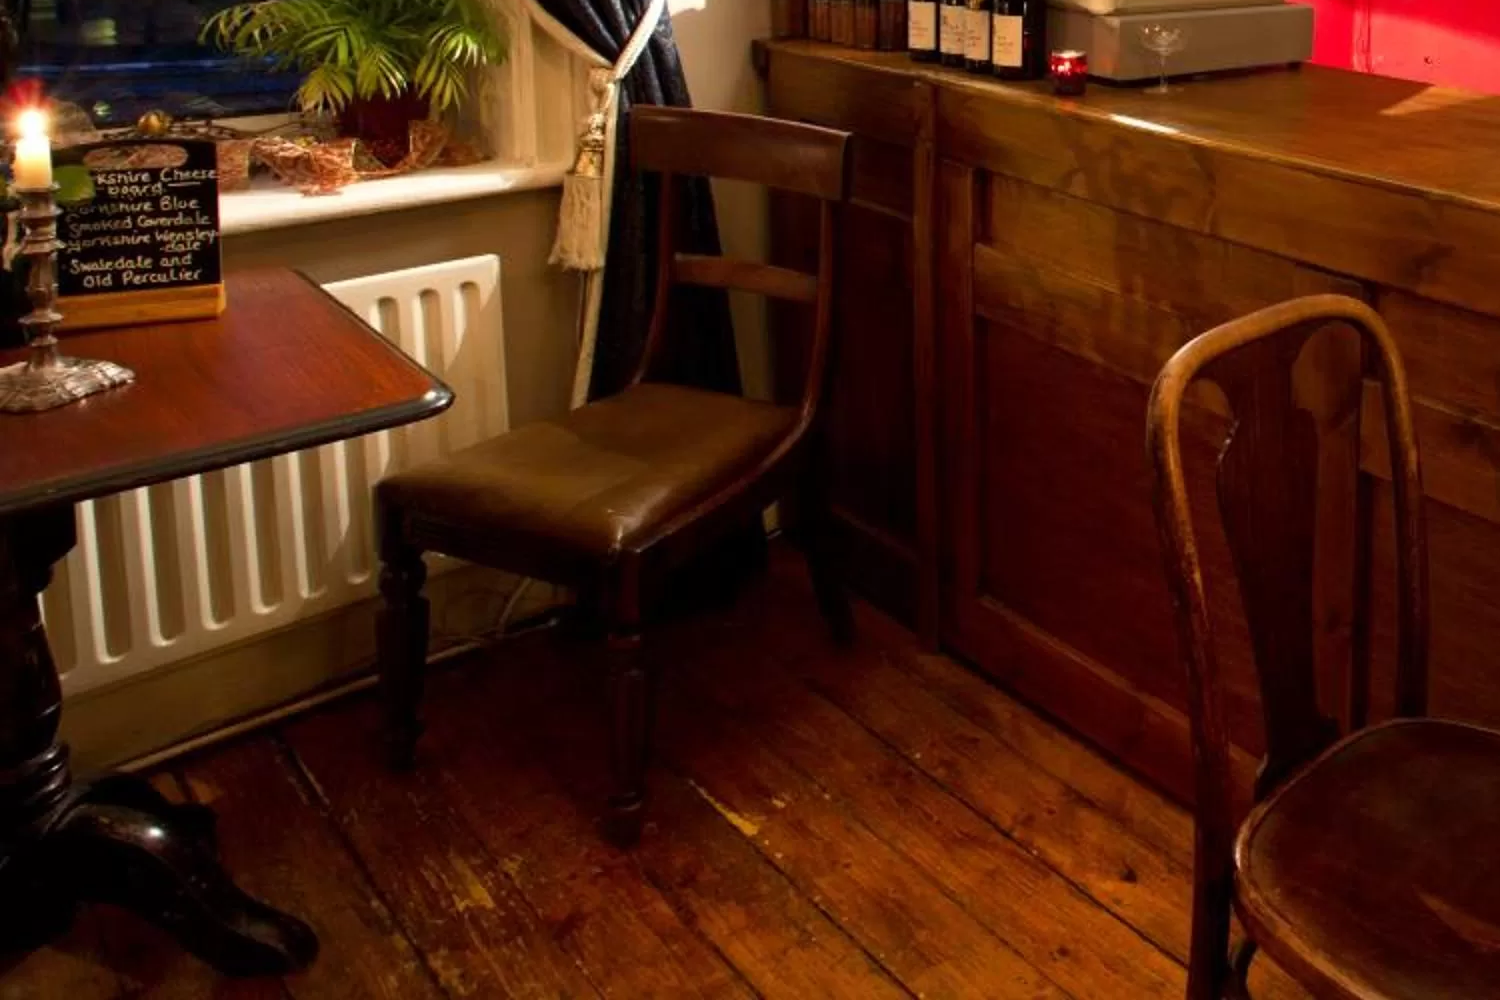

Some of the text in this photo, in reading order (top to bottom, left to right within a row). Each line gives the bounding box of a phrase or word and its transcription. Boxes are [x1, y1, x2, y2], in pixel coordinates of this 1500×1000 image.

[96, 167, 219, 185] kshire Cheese
[160, 195, 201, 211] Blue
[70, 252, 193, 275] Swaledale and
[83, 273, 113, 288] Old
